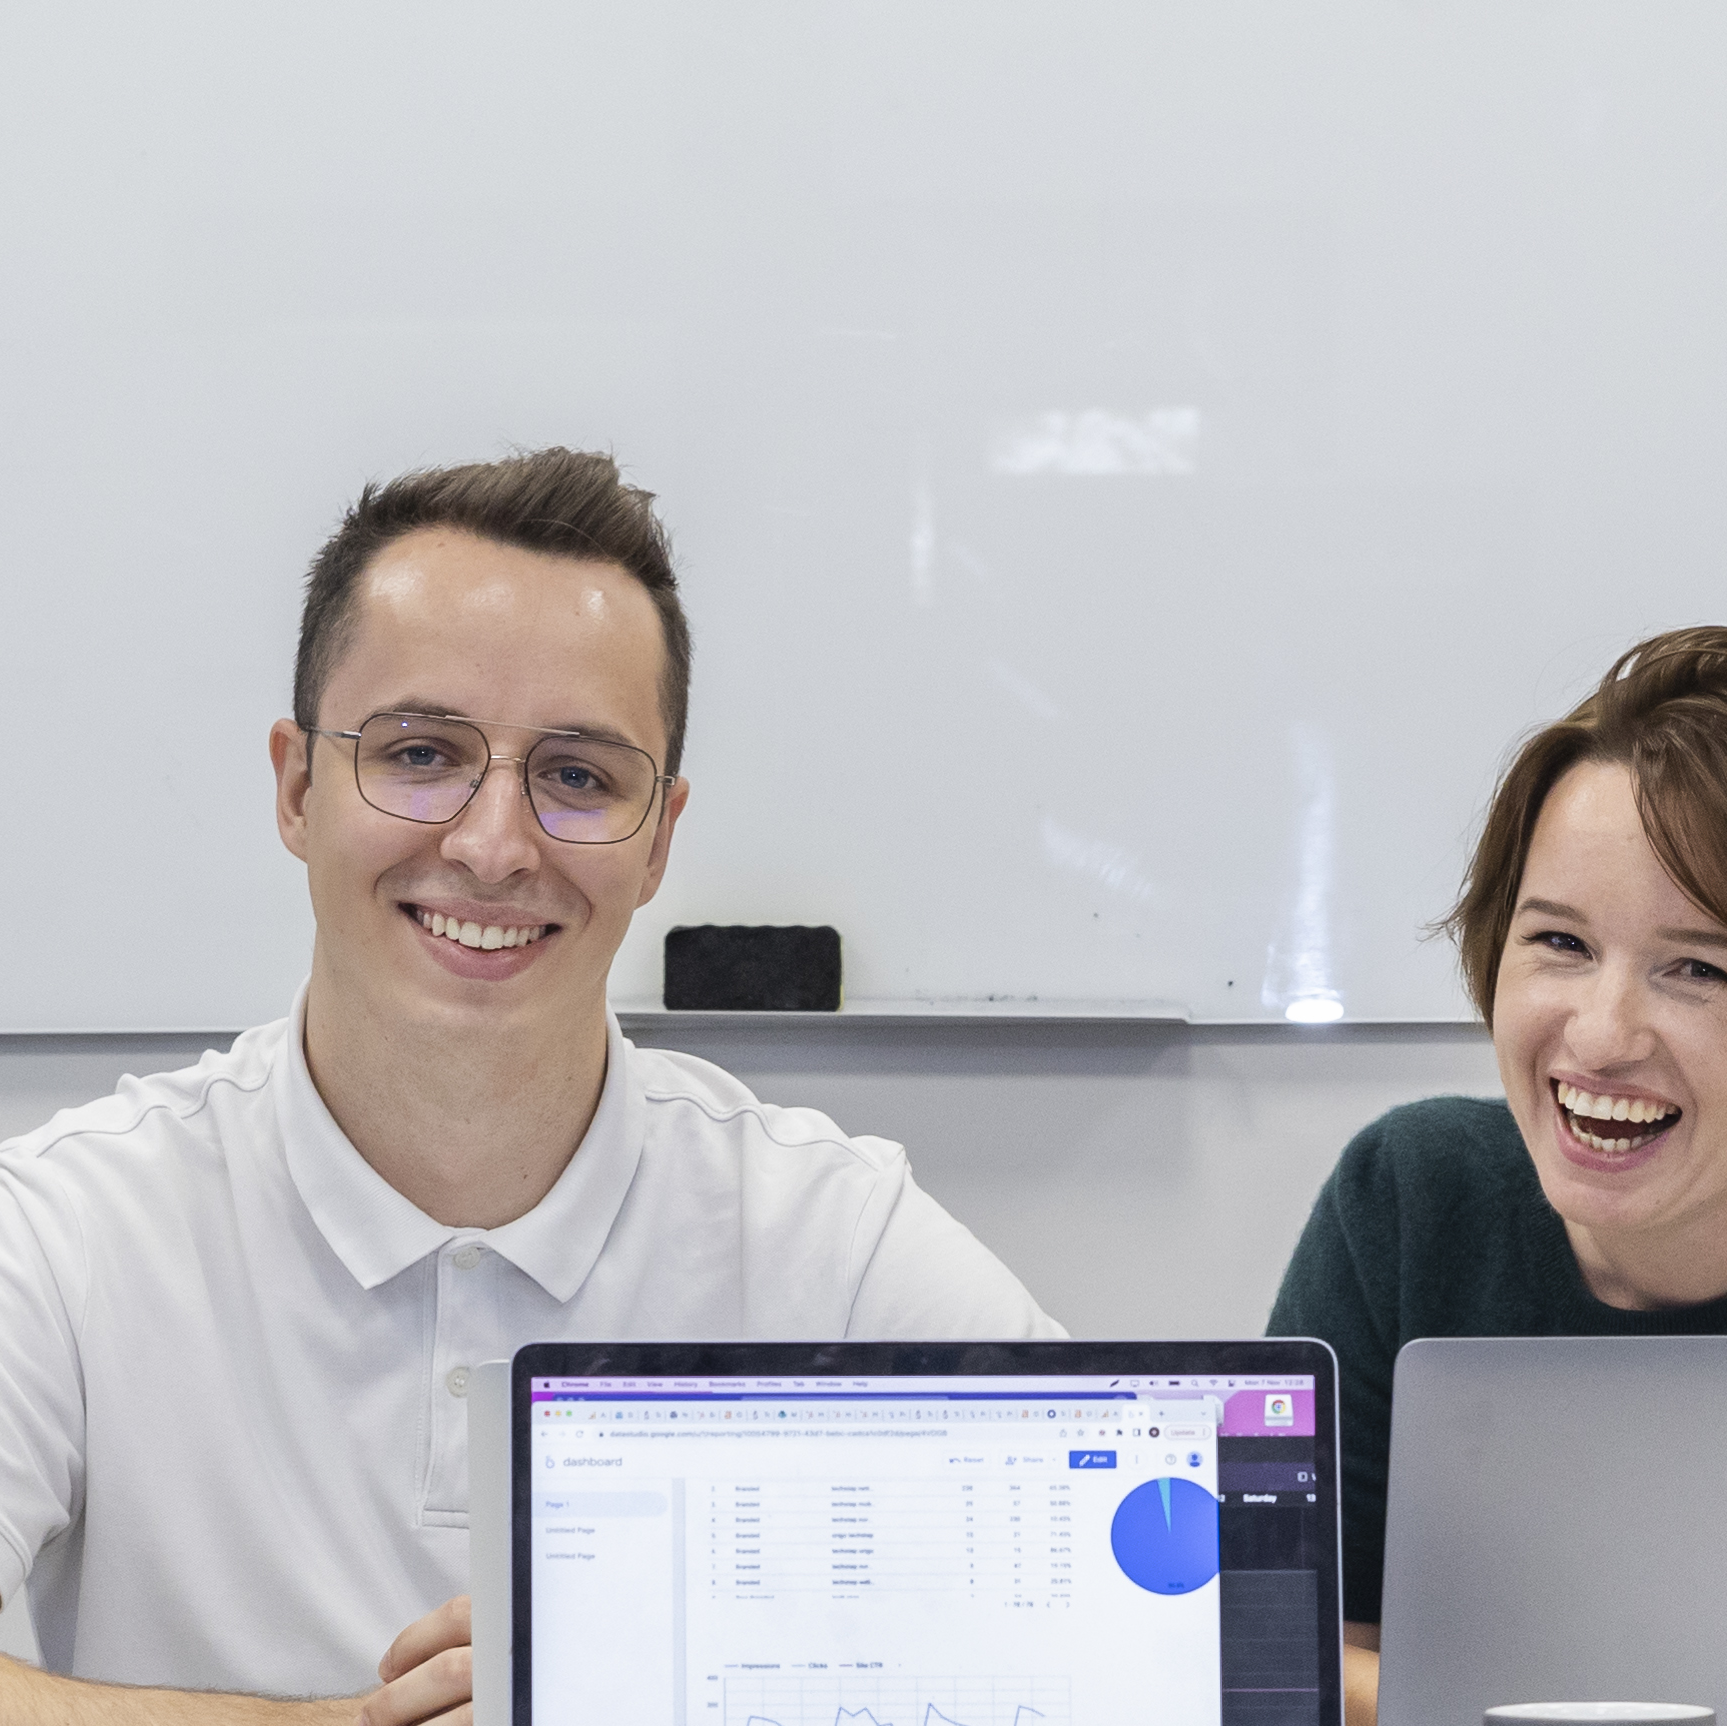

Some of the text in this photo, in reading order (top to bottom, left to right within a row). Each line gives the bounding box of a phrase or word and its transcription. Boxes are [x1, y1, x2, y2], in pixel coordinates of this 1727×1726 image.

[563, 1457, 623, 1468] dashboard
[1242, 1494, 1278, 1504] Saturday
[546, 1501, 564, 1509] Page
